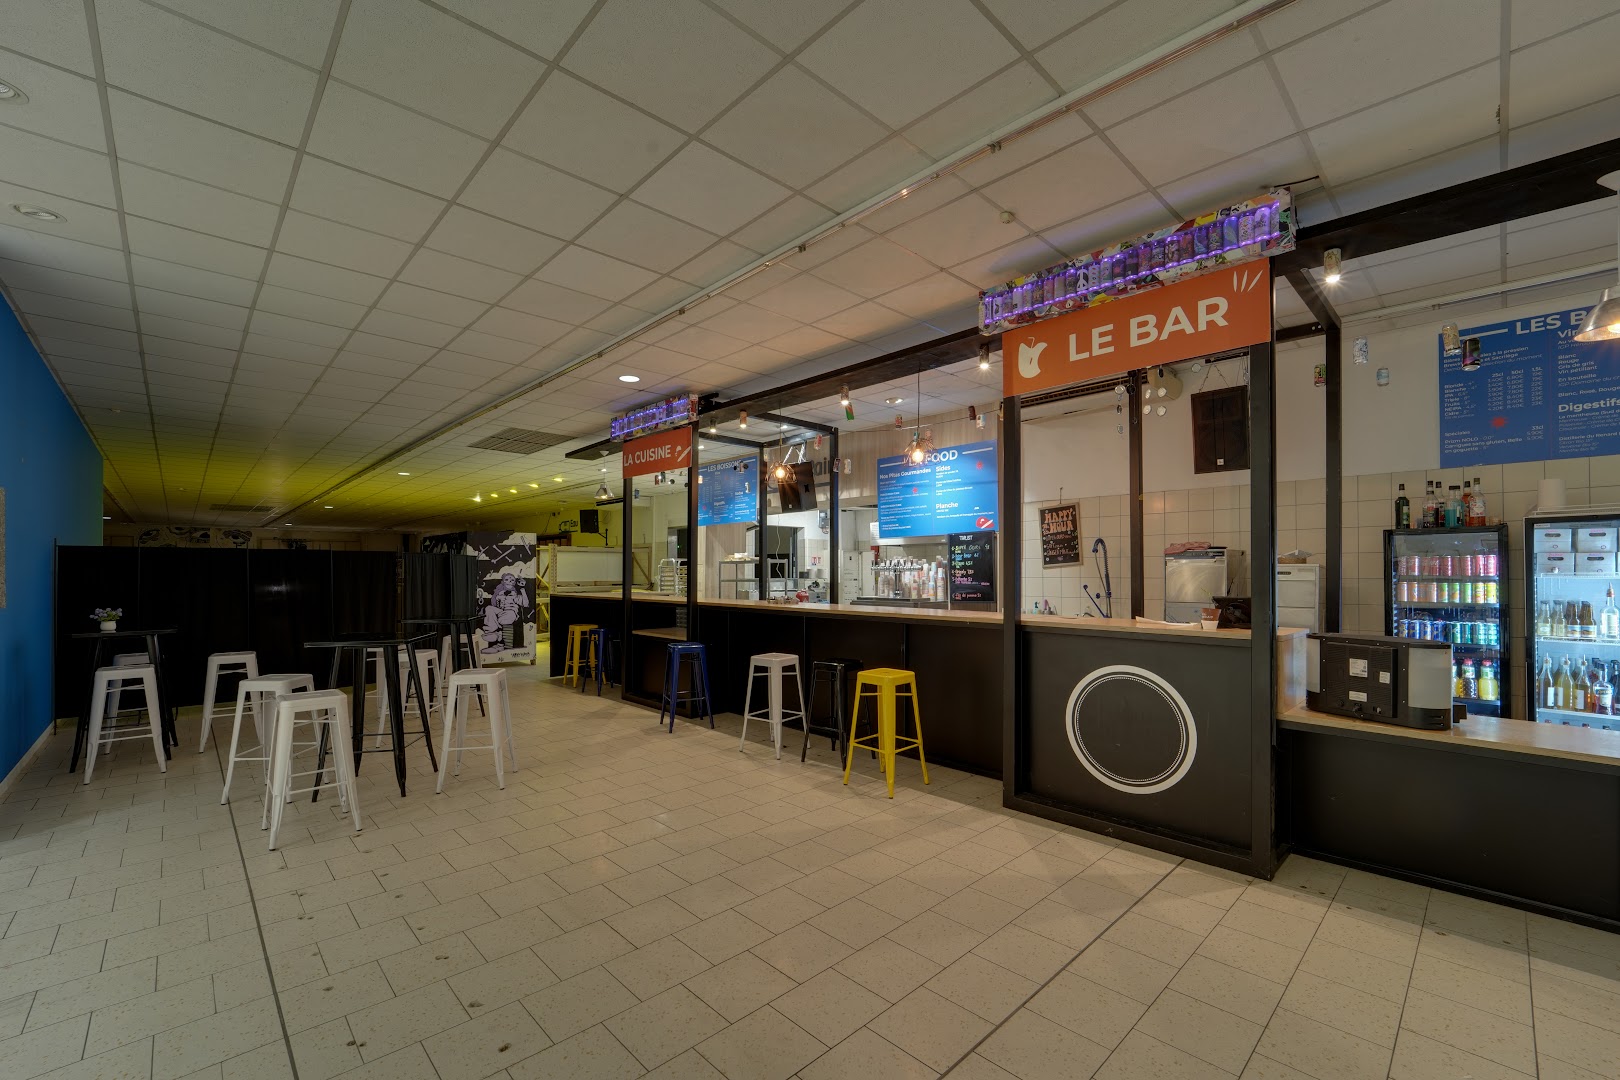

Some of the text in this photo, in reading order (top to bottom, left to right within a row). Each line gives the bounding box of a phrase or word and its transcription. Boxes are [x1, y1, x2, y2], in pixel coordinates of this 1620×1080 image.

[1069, 296, 1228, 362] LE BAR
[1516, 315, 1561, 334] LES
[1558, 398, 1620, 412] Digestifs
[624, 444, 672, 467] LA CUISINE
[901, 468, 931, 476] Gourmandes
[936, 502, 958, 510] Planche
[1044, 508, 1072, 523] HAPPY
[1049, 521, 1074, 534] HOUR
